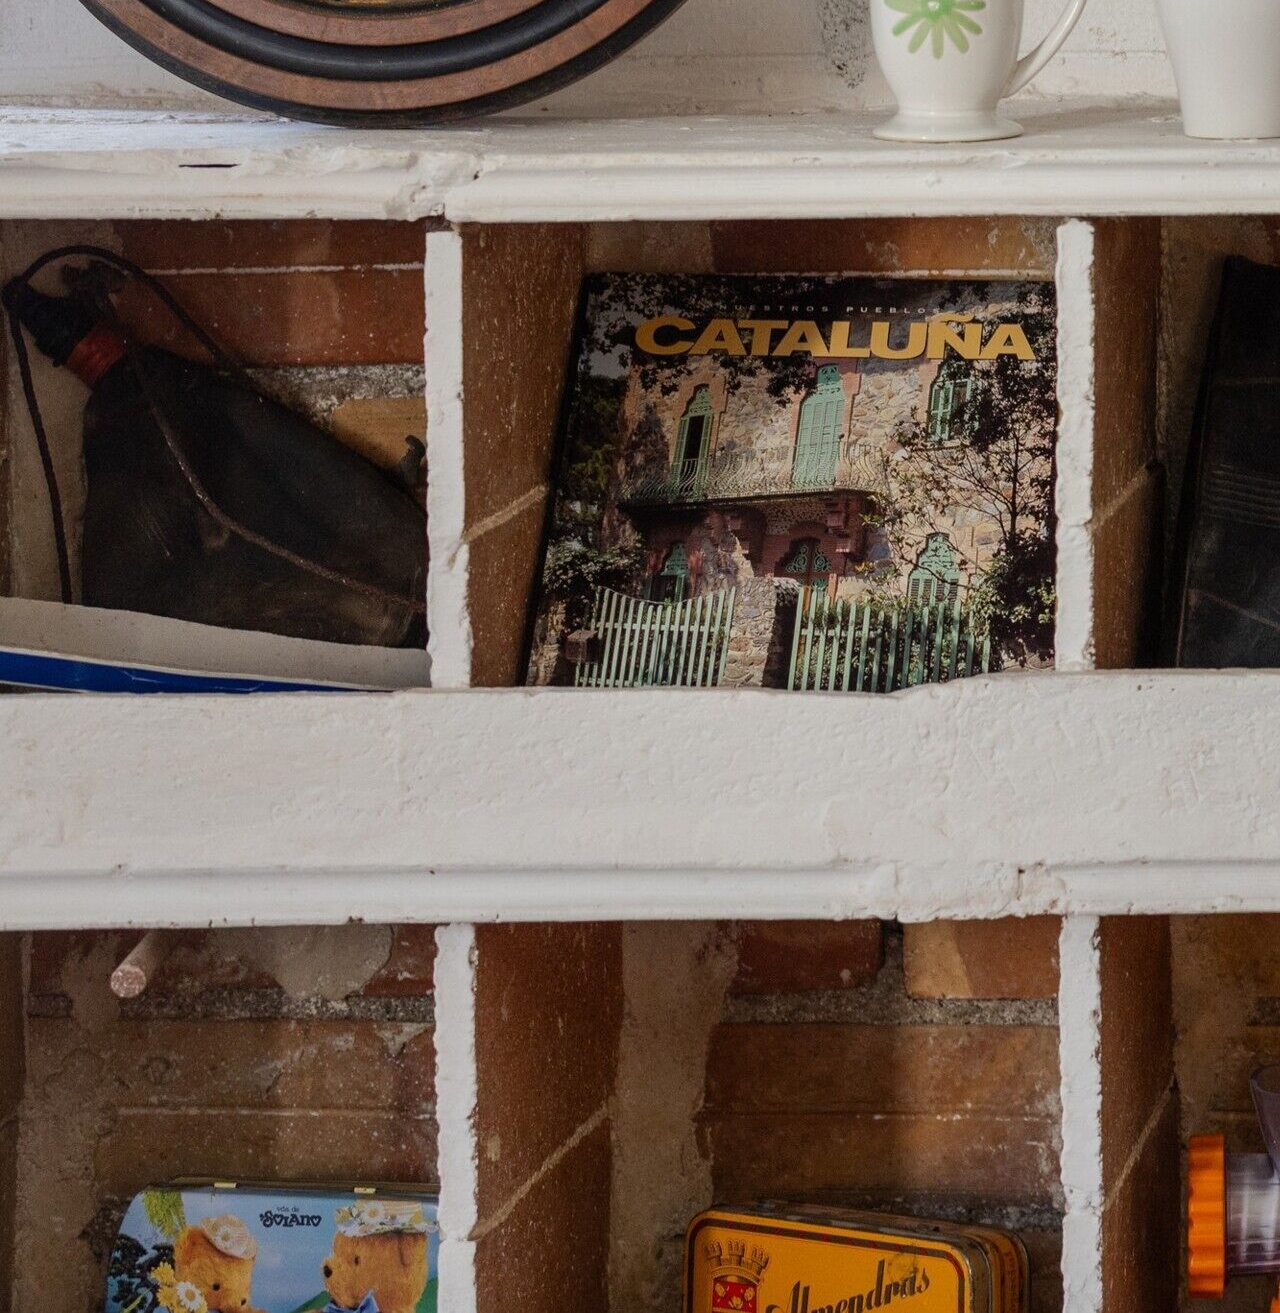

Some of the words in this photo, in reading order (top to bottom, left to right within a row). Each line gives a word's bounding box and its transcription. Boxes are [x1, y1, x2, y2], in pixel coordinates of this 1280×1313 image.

[719, 304, 829, 313] NUESTROS
[845, 305, 941, 314] PUEBLOS
[634, 313, 1036, 360] CATALUÑA
